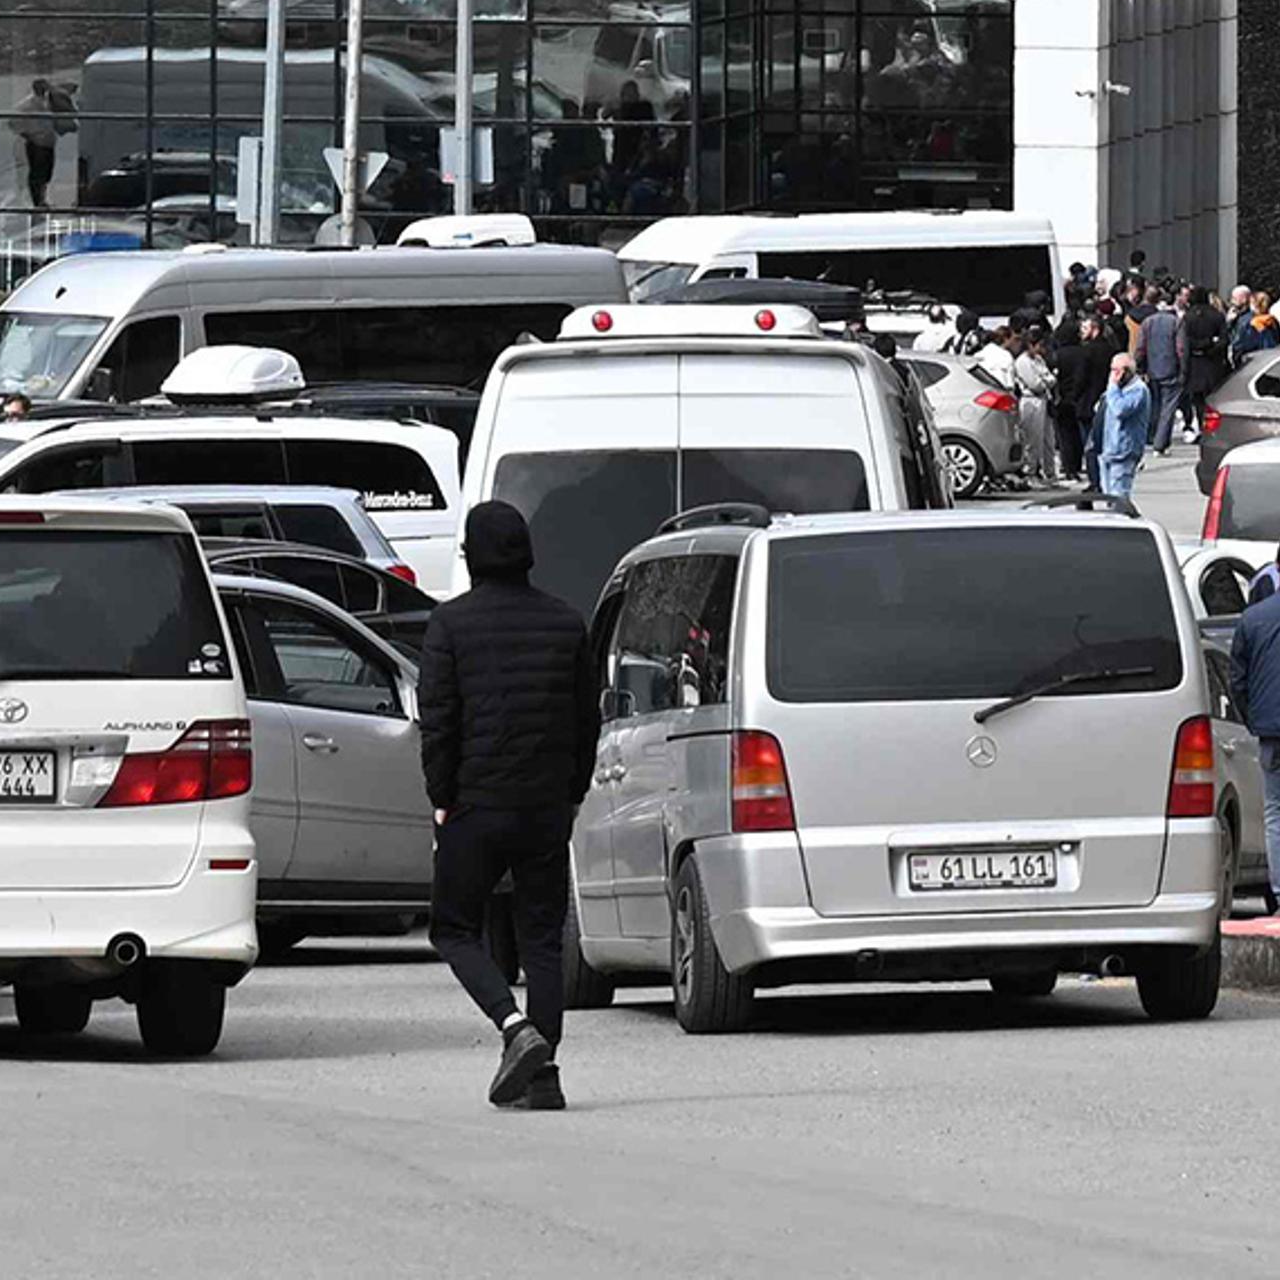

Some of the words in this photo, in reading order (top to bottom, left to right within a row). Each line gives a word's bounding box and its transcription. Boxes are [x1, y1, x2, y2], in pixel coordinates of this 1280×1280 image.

[22, 755, 48, 775] XX
[2, 777, 35, 797] 444
[940, 857, 965, 880] 61
[972, 856, 1003, 879] LL
[1009, 855, 1047, 878] 161
